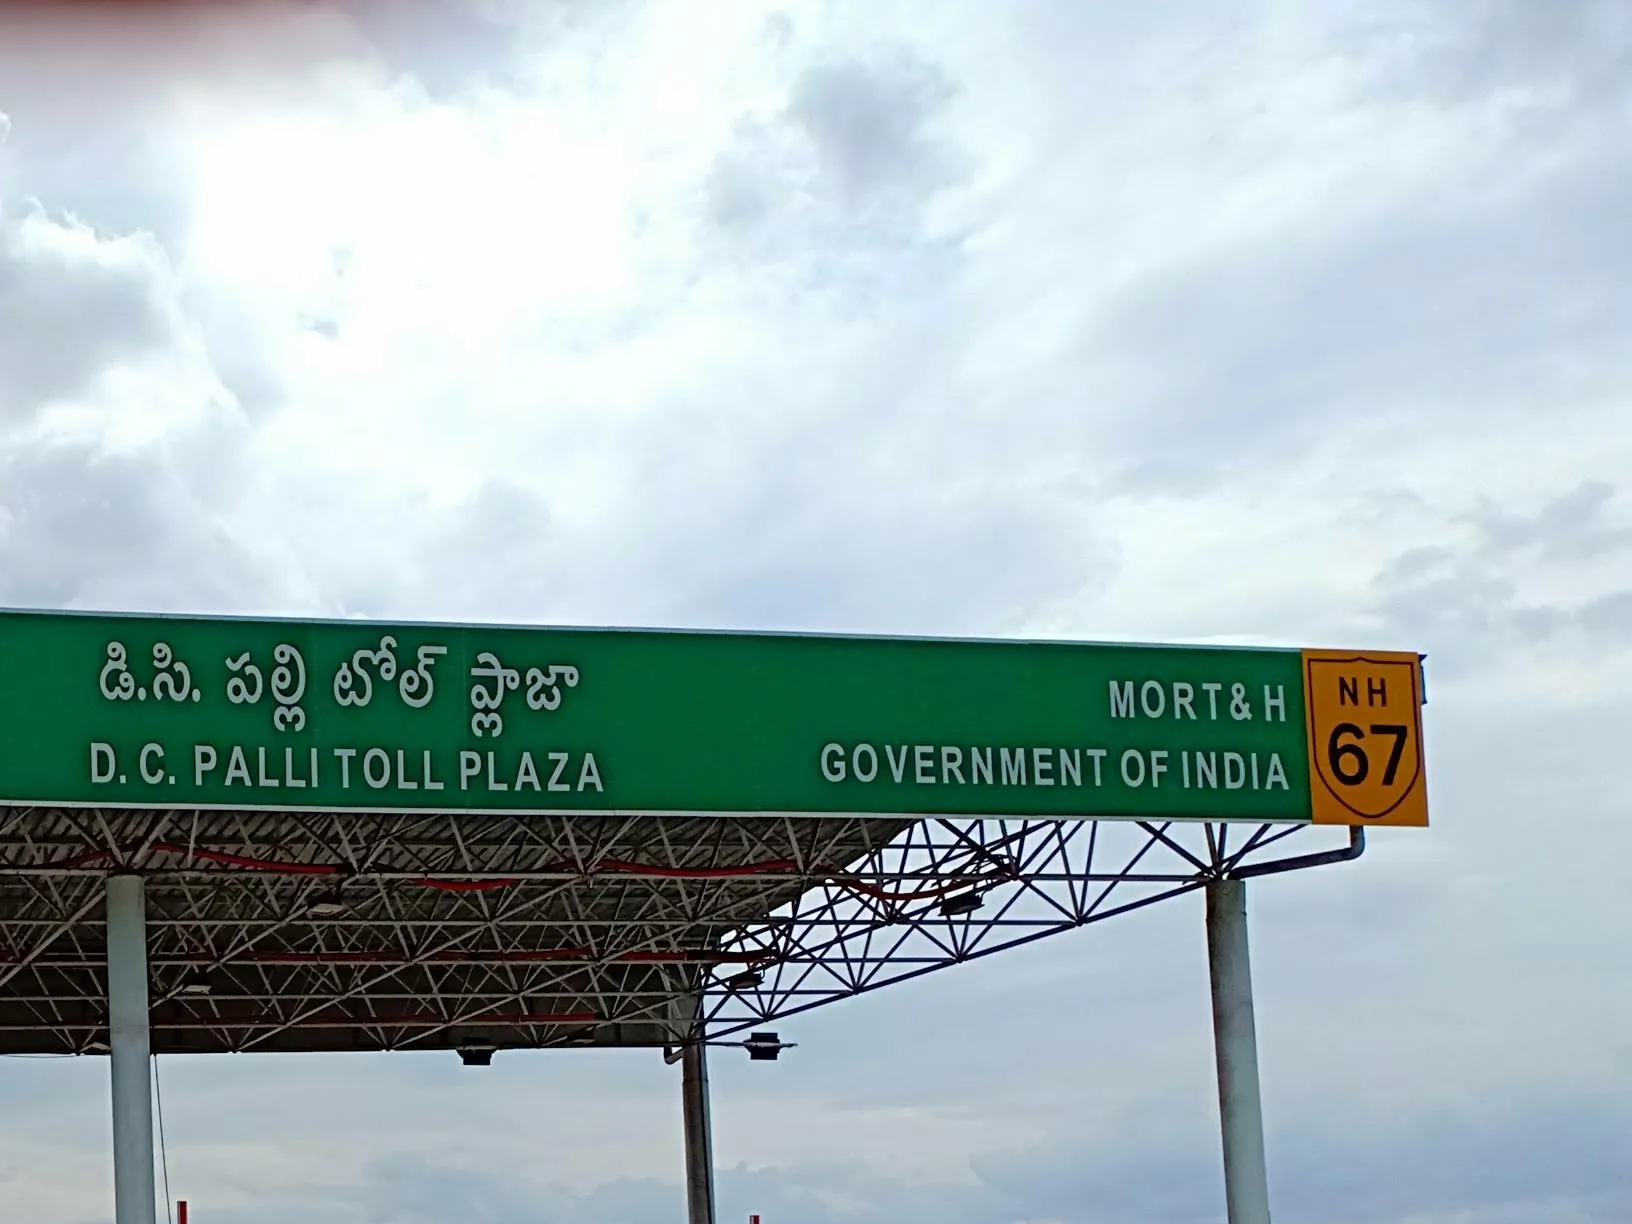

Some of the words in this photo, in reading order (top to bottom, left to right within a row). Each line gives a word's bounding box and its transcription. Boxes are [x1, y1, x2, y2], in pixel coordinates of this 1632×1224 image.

[333, 635, 448, 709] టోల్
[1338, 676, 1389, 708] NH
[194, 745, 319, 789] PALLI
[334, 748, 445, 790] TOLL
[460, 750, 605, 793] PLAZA
[820, 743, 1108, 787] GOVERNMENT
[1121, 749, 1170, 788] OF
[1182, 751, 1290, 791] INDIA
[1327, 722, 1408, 787] 67
